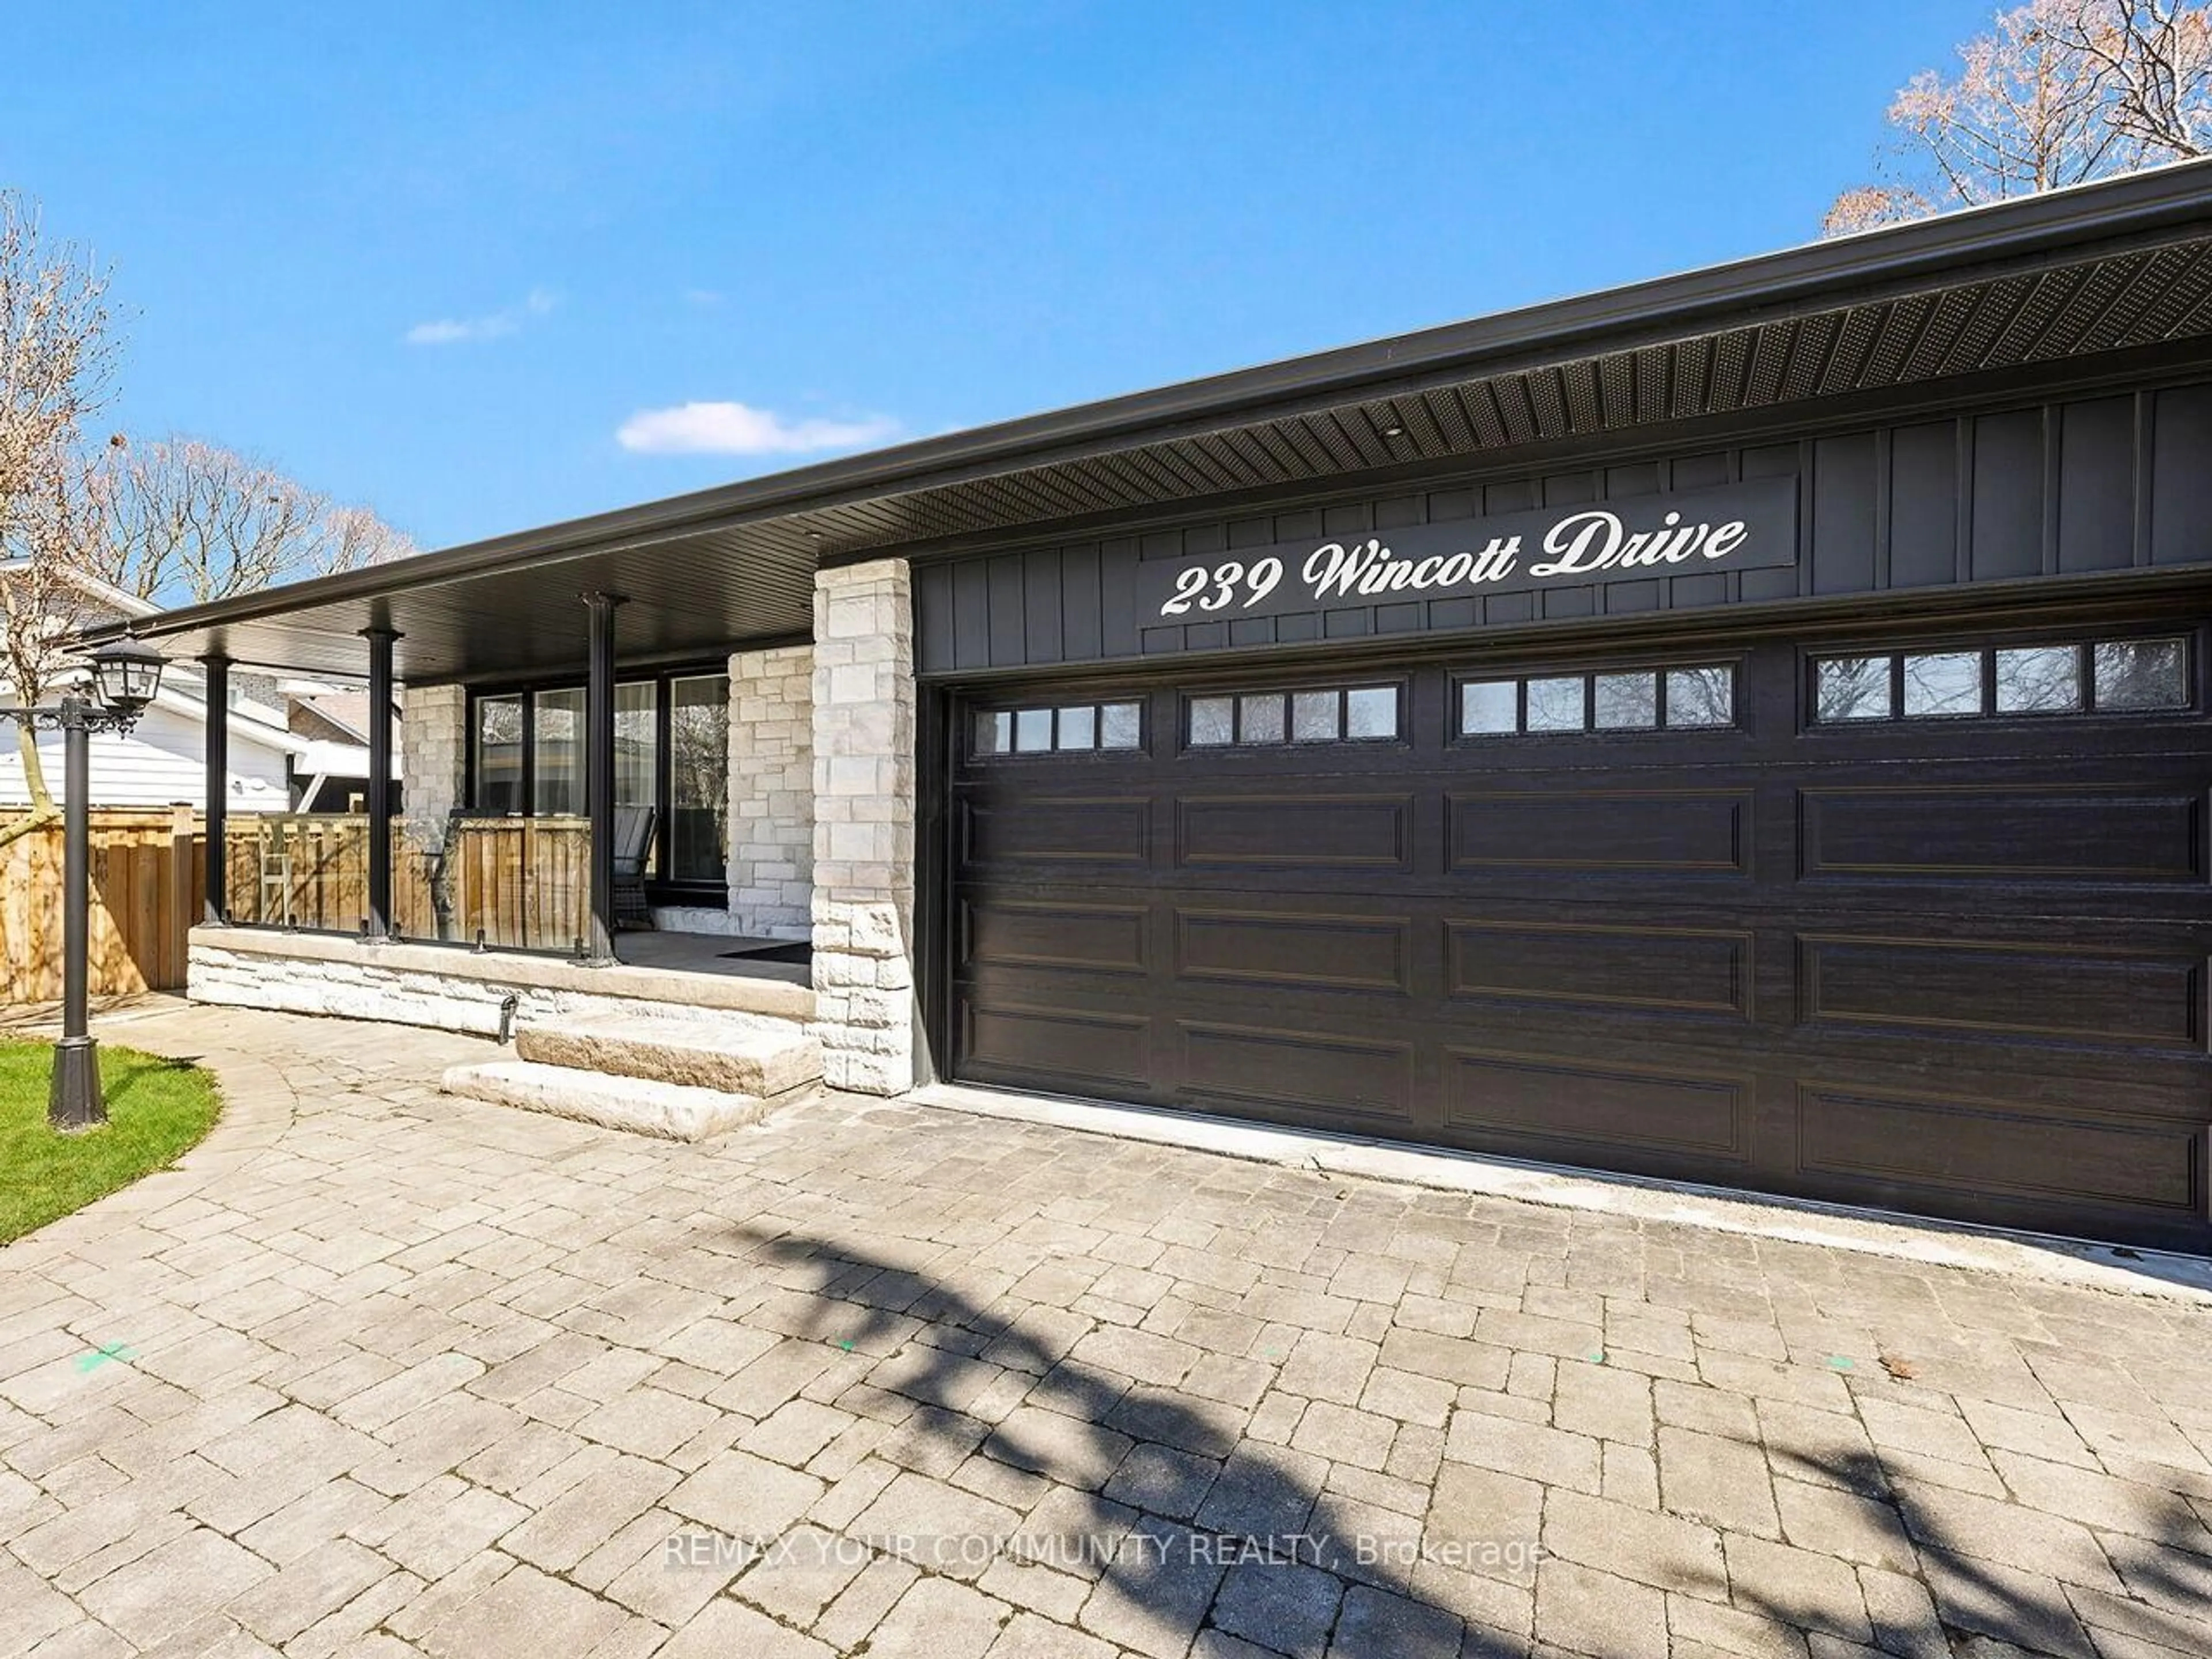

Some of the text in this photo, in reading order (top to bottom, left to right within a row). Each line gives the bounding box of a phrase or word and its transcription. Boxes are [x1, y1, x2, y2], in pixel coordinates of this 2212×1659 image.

[1161, 512, 1748, 616] 239 Wincott Drive
